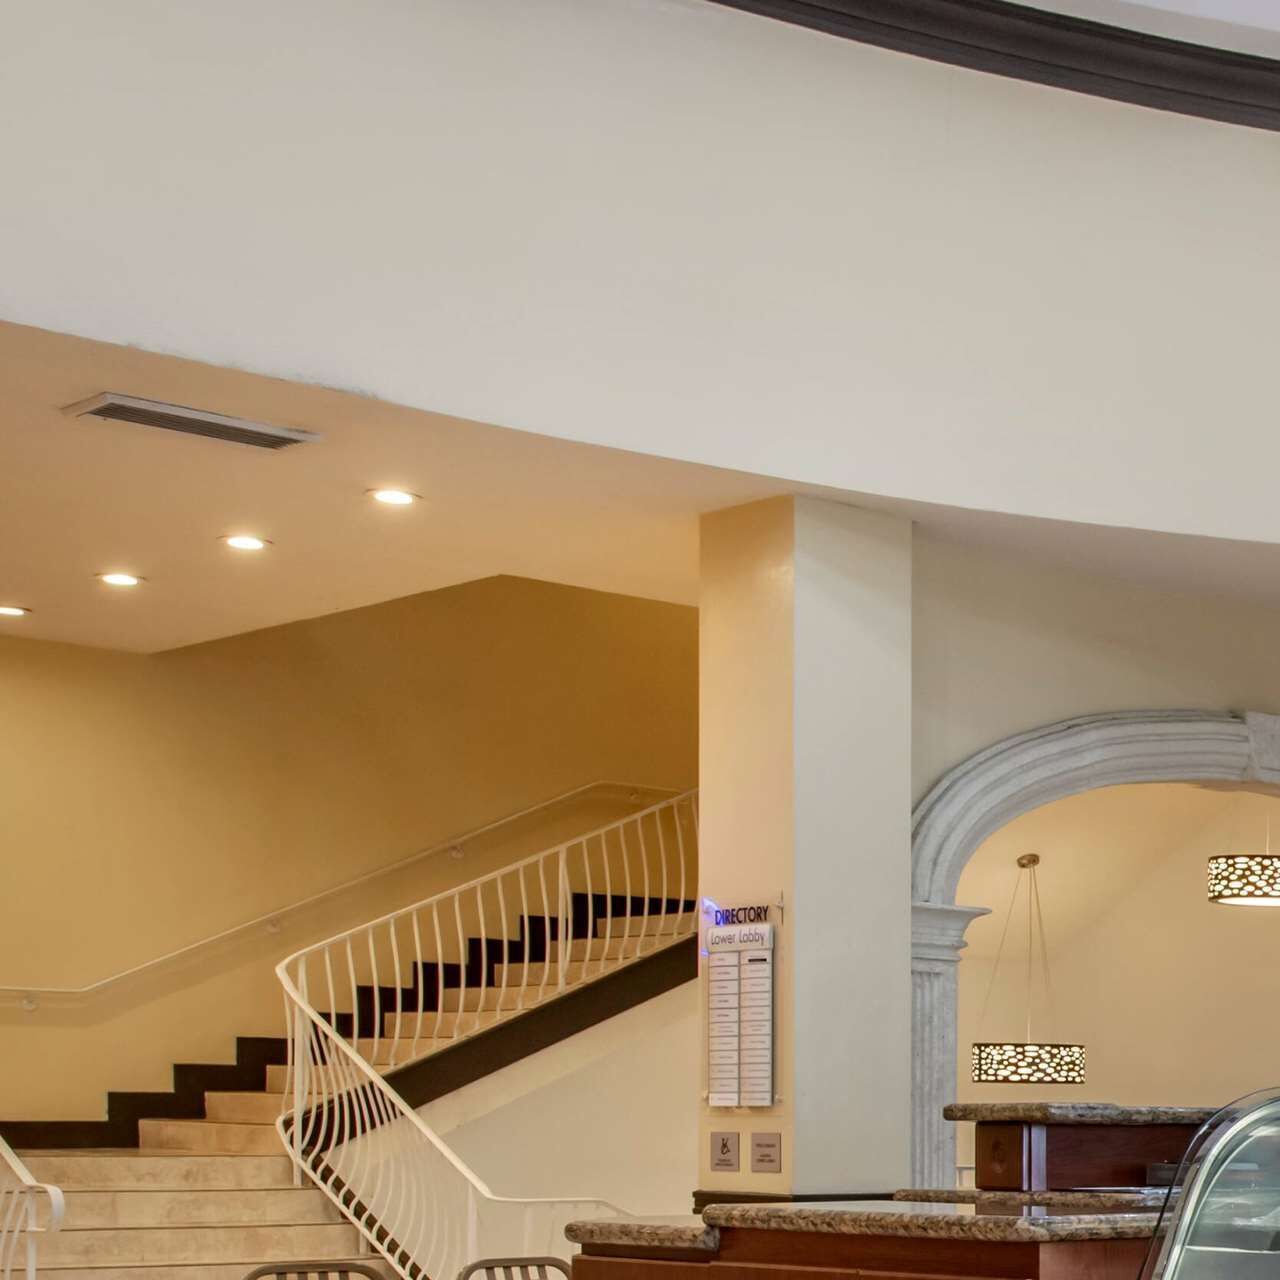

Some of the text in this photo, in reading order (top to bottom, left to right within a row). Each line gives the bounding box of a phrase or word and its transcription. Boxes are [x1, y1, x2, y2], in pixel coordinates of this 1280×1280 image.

[714, 905, 769, 925] DIRECTORY
[711, 927, 766, 946] Lower Lobby
